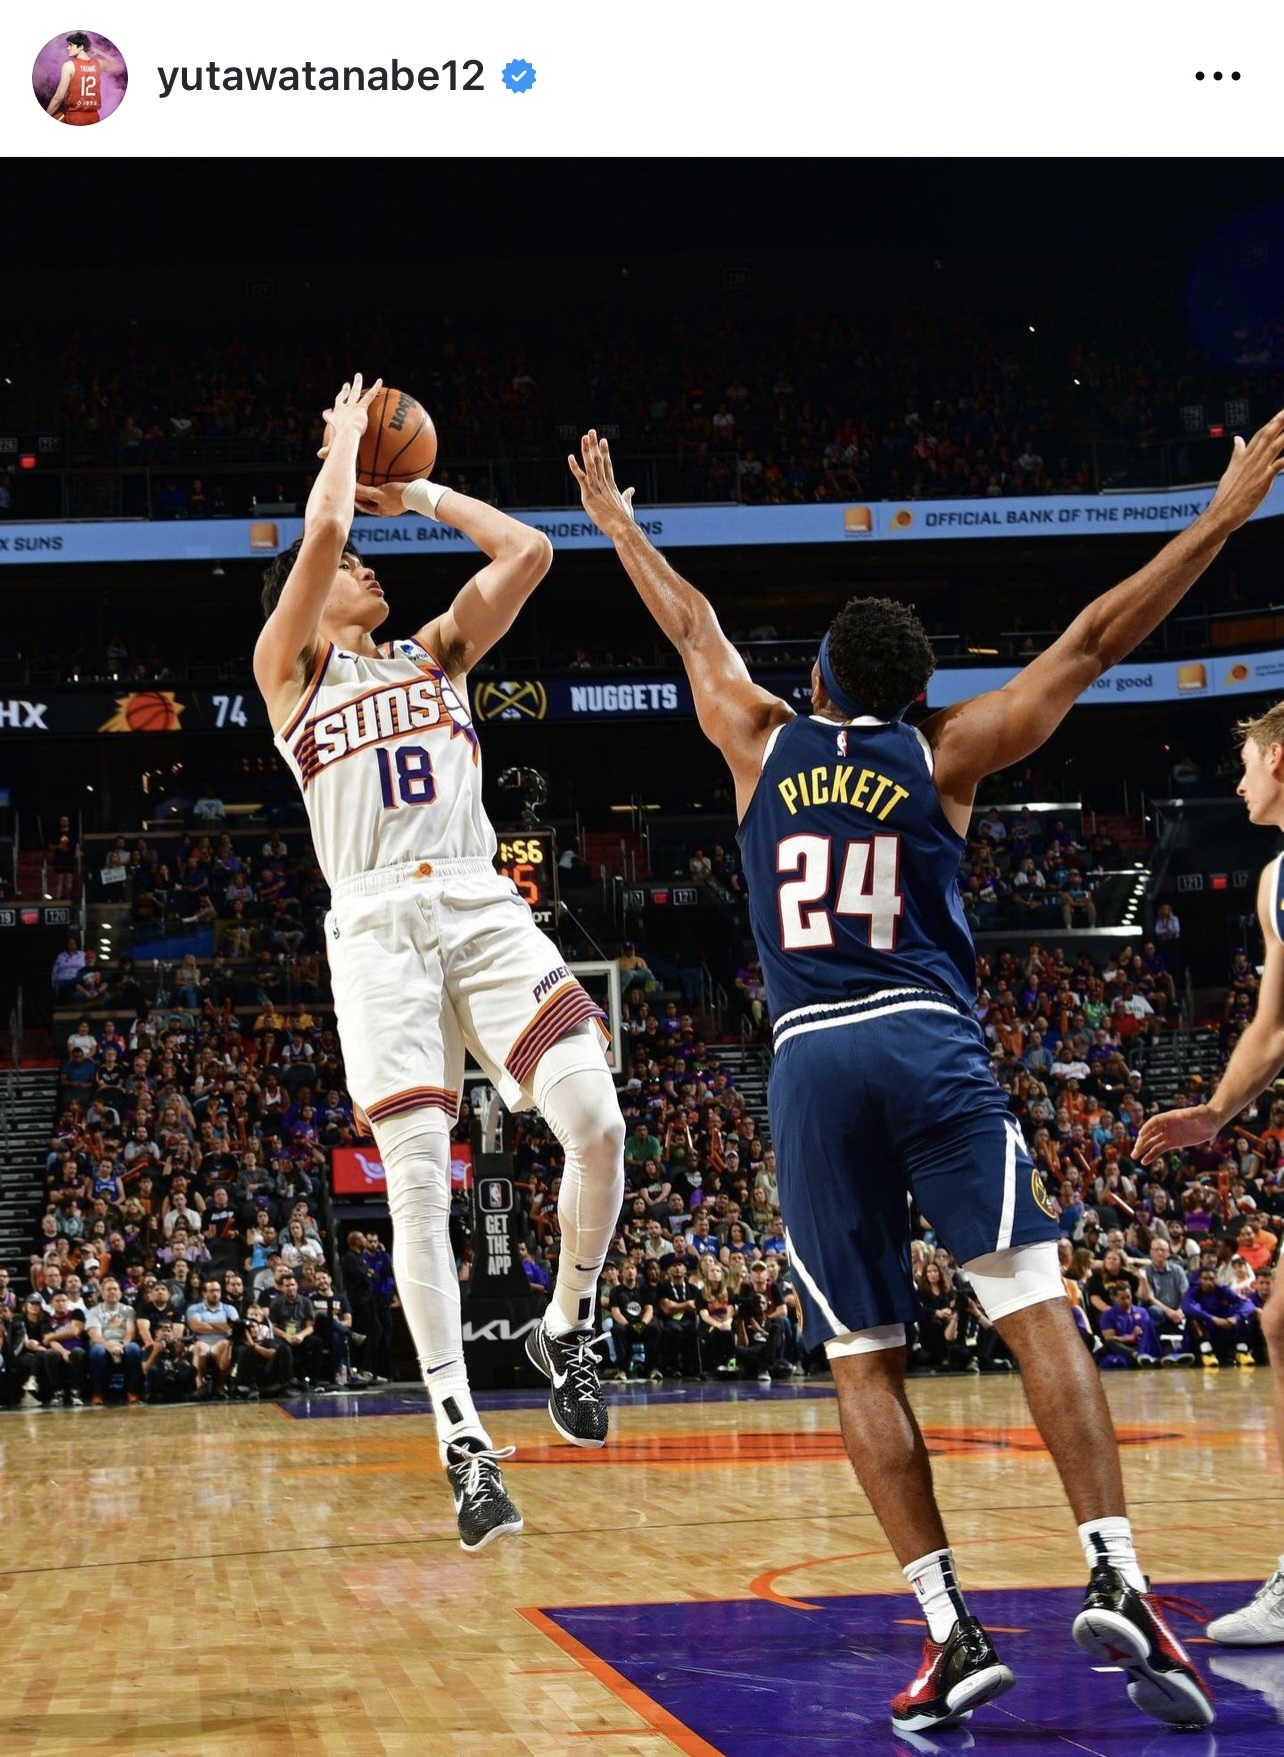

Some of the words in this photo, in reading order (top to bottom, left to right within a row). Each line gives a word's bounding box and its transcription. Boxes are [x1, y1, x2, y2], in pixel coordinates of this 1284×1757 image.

[925, 510, 1002, 527] OFFICIAL
[1006, 509, 1054, 524] BANK
[1058, 508, 1081, 523] OF
[1085, 507, 1118, 521] THE
[1123, 503, 1202, 520] PHOENIX
[13, 536, 63, 551] SUNS
[350, 528, 412, 542] FFICIAL
[1116, 674, 1153, 692] good
[570, 683, 678, 711] NUGGETS
[0, 700, 48, 729] HX
[212, 695, 248, 727] 74
[375, 746, 437, 810] 18
[778, 765, 910, 821] PICKETT
[776, 832, 904, 953] 24
[485, 1214, 509, 1234] GET
[486, 1235, 510, 1254] THE
[488, 1256, 511, 1275] APP
